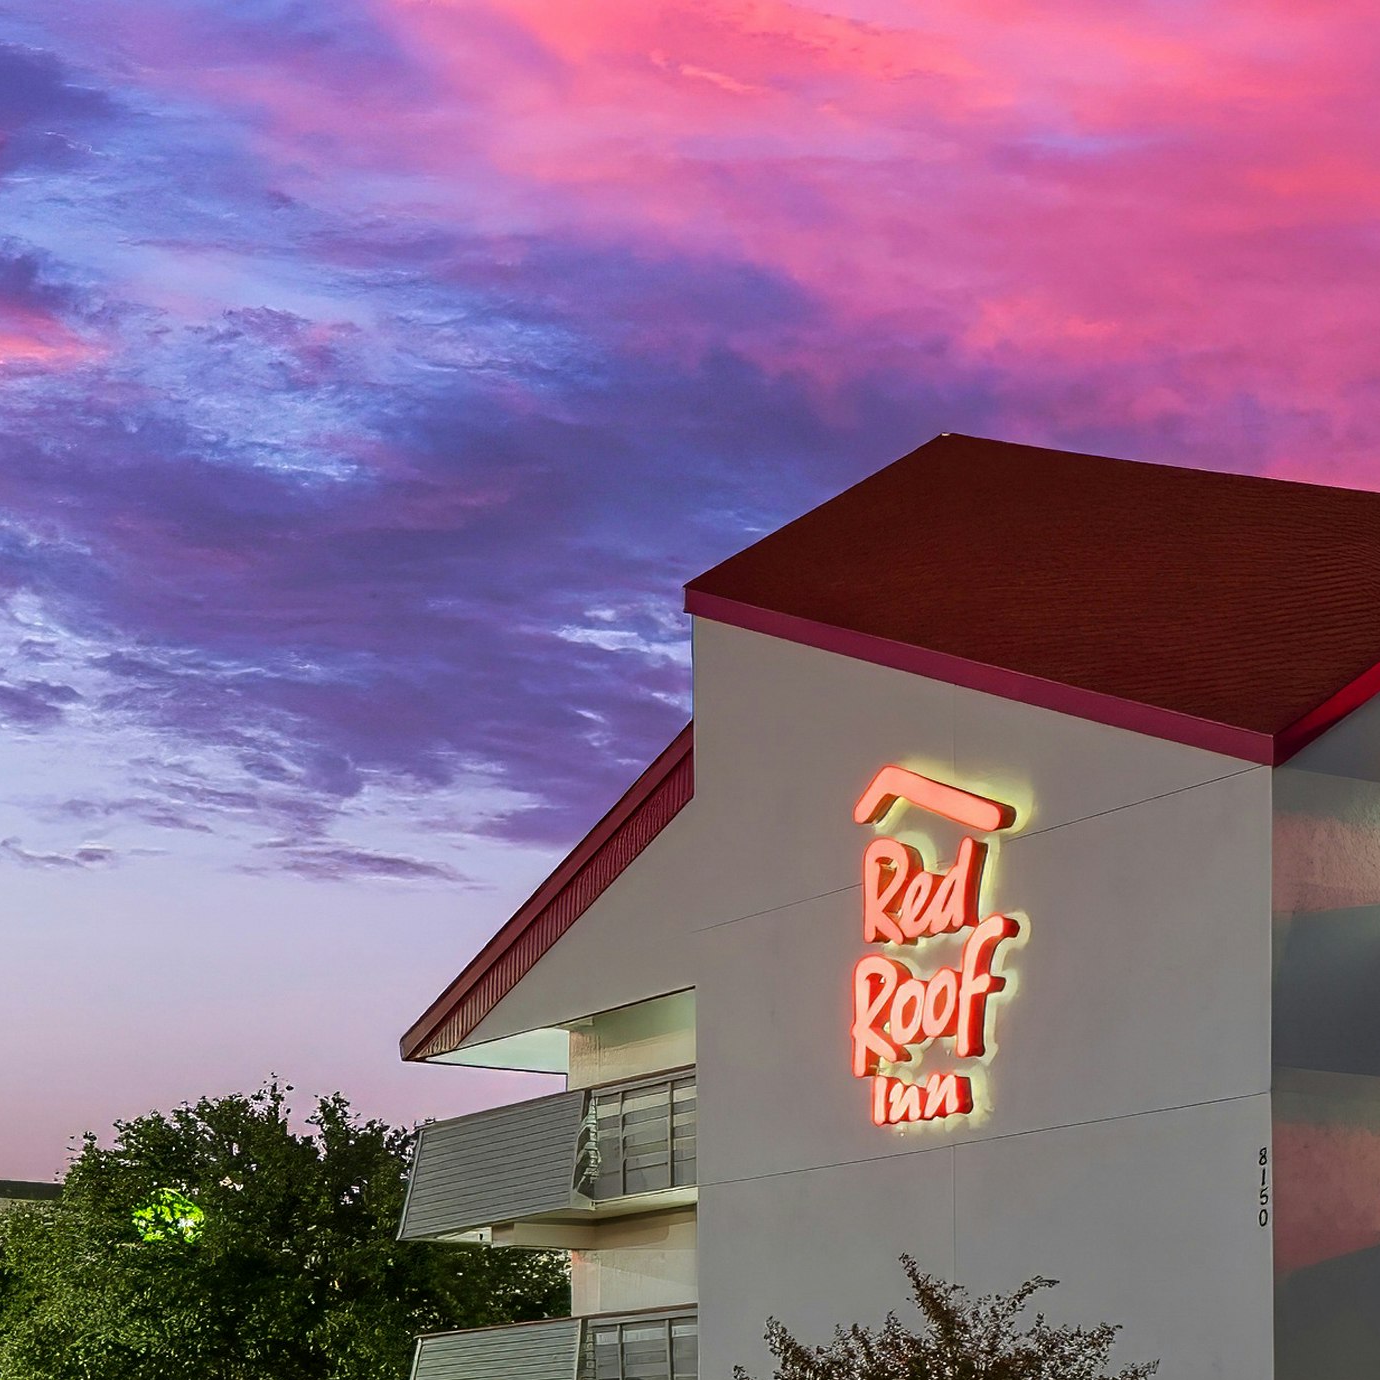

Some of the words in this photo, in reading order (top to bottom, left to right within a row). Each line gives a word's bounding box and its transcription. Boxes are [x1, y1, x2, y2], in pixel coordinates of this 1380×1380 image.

[862, 836, 988, 946] Red
[851, 912, 1021, 1078] Roof
[1258, 1146, 1269, 1227] 8150
